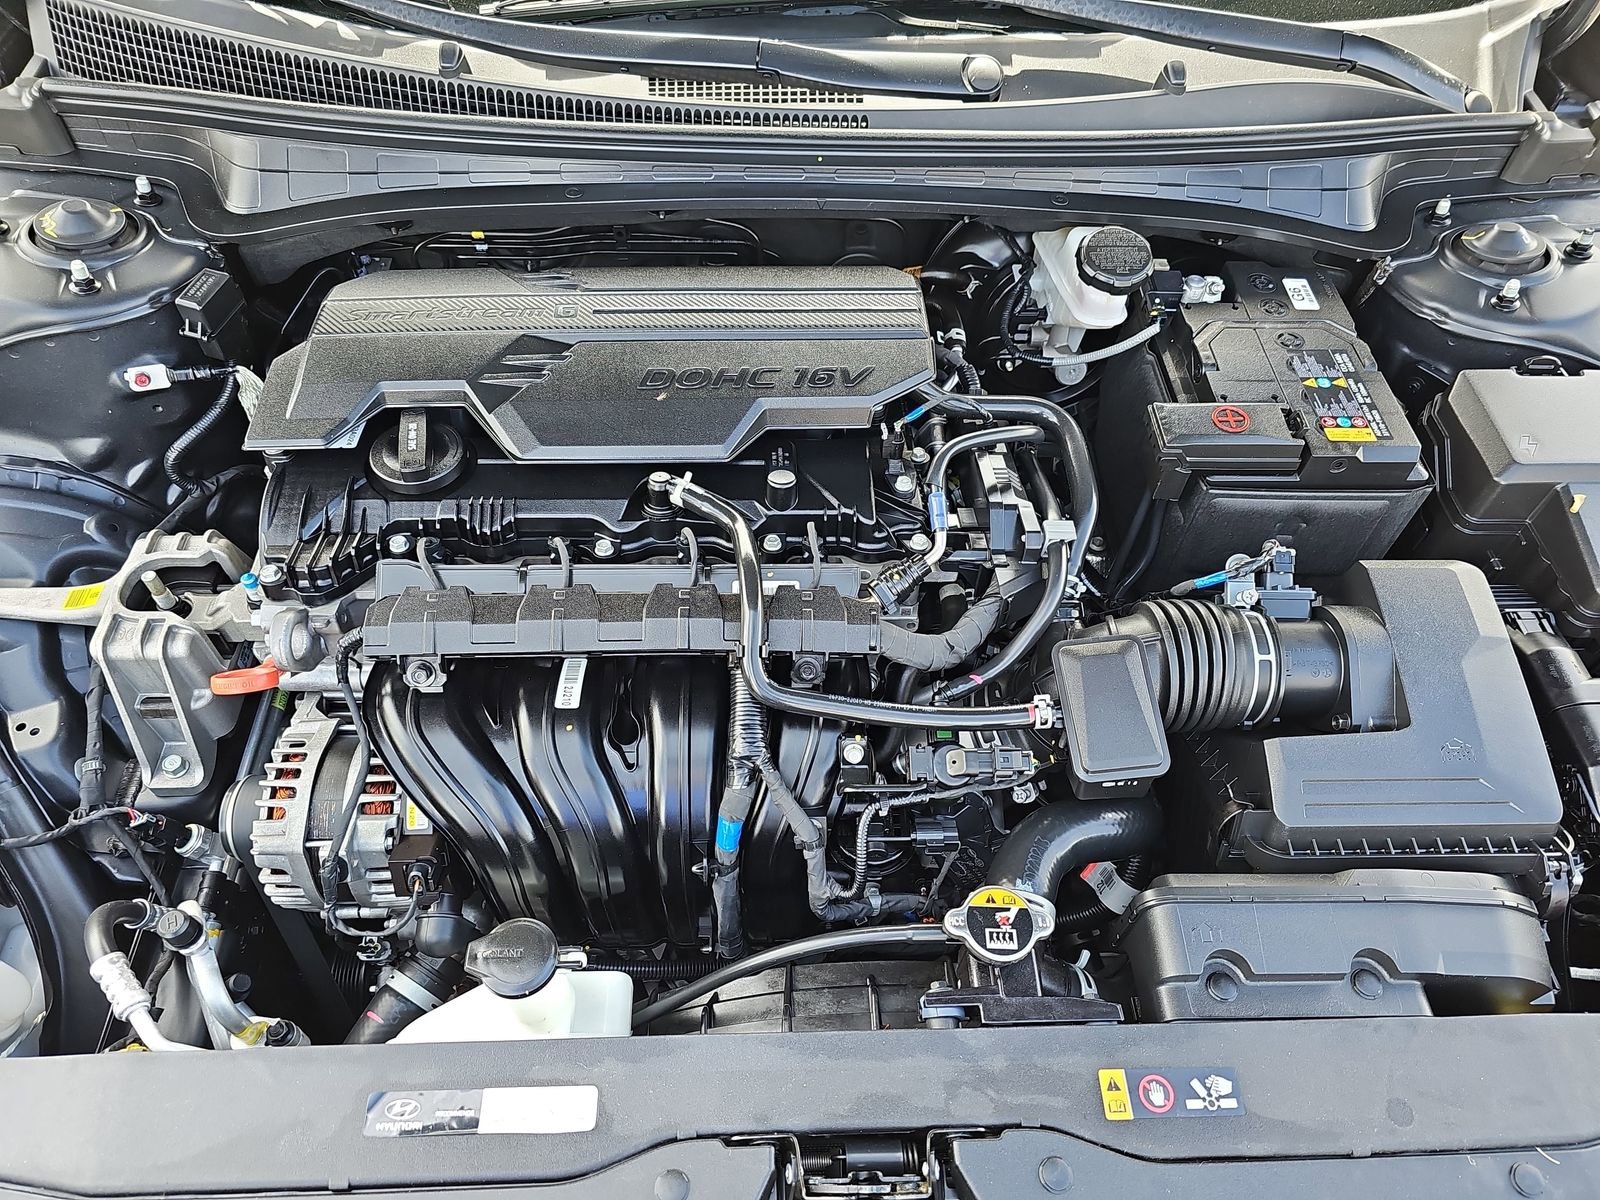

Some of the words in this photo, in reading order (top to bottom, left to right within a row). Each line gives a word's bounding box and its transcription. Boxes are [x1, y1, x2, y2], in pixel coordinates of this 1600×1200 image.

[343, 306, 547, 324] Smartstream
[637, 366, 783, 390] DOHC
[793, 365, 877, 389] 16V
[561, 685, 574, 707] 2J210
[948, 915, 966, 927] HCC
[375, 1120, 424, 1134] HYUNDAI
